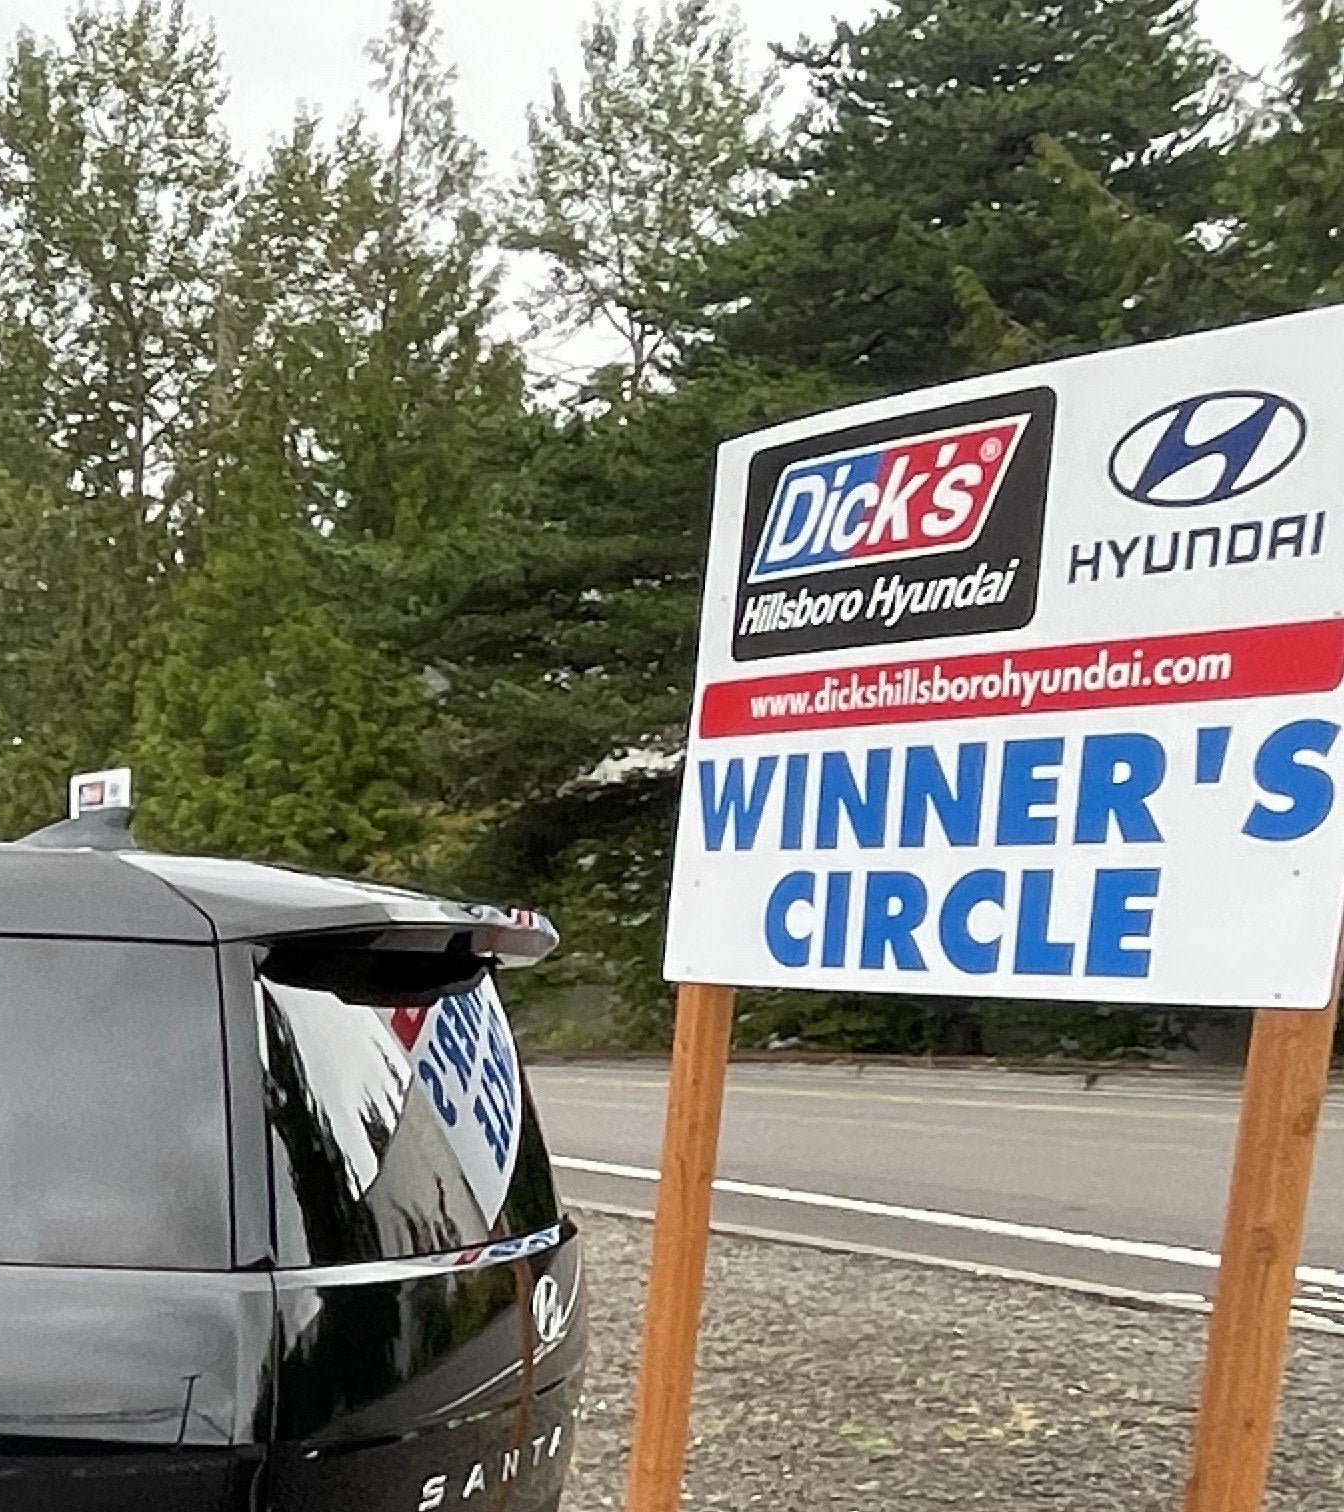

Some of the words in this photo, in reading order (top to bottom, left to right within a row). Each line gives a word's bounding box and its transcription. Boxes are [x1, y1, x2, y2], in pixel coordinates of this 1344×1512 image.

[1068, 510, 1326, 584] HYUNDAI
[738, 588, 863, 636] Hillsboro
[865, 558, 1021, 627] Hyundai
[750, 649, 1232, 718] www.dickshillsborohyundai.com
[699, 719, 1341, 851] WINNER'S
[764, 867, 1161, 978] CIRCLE
